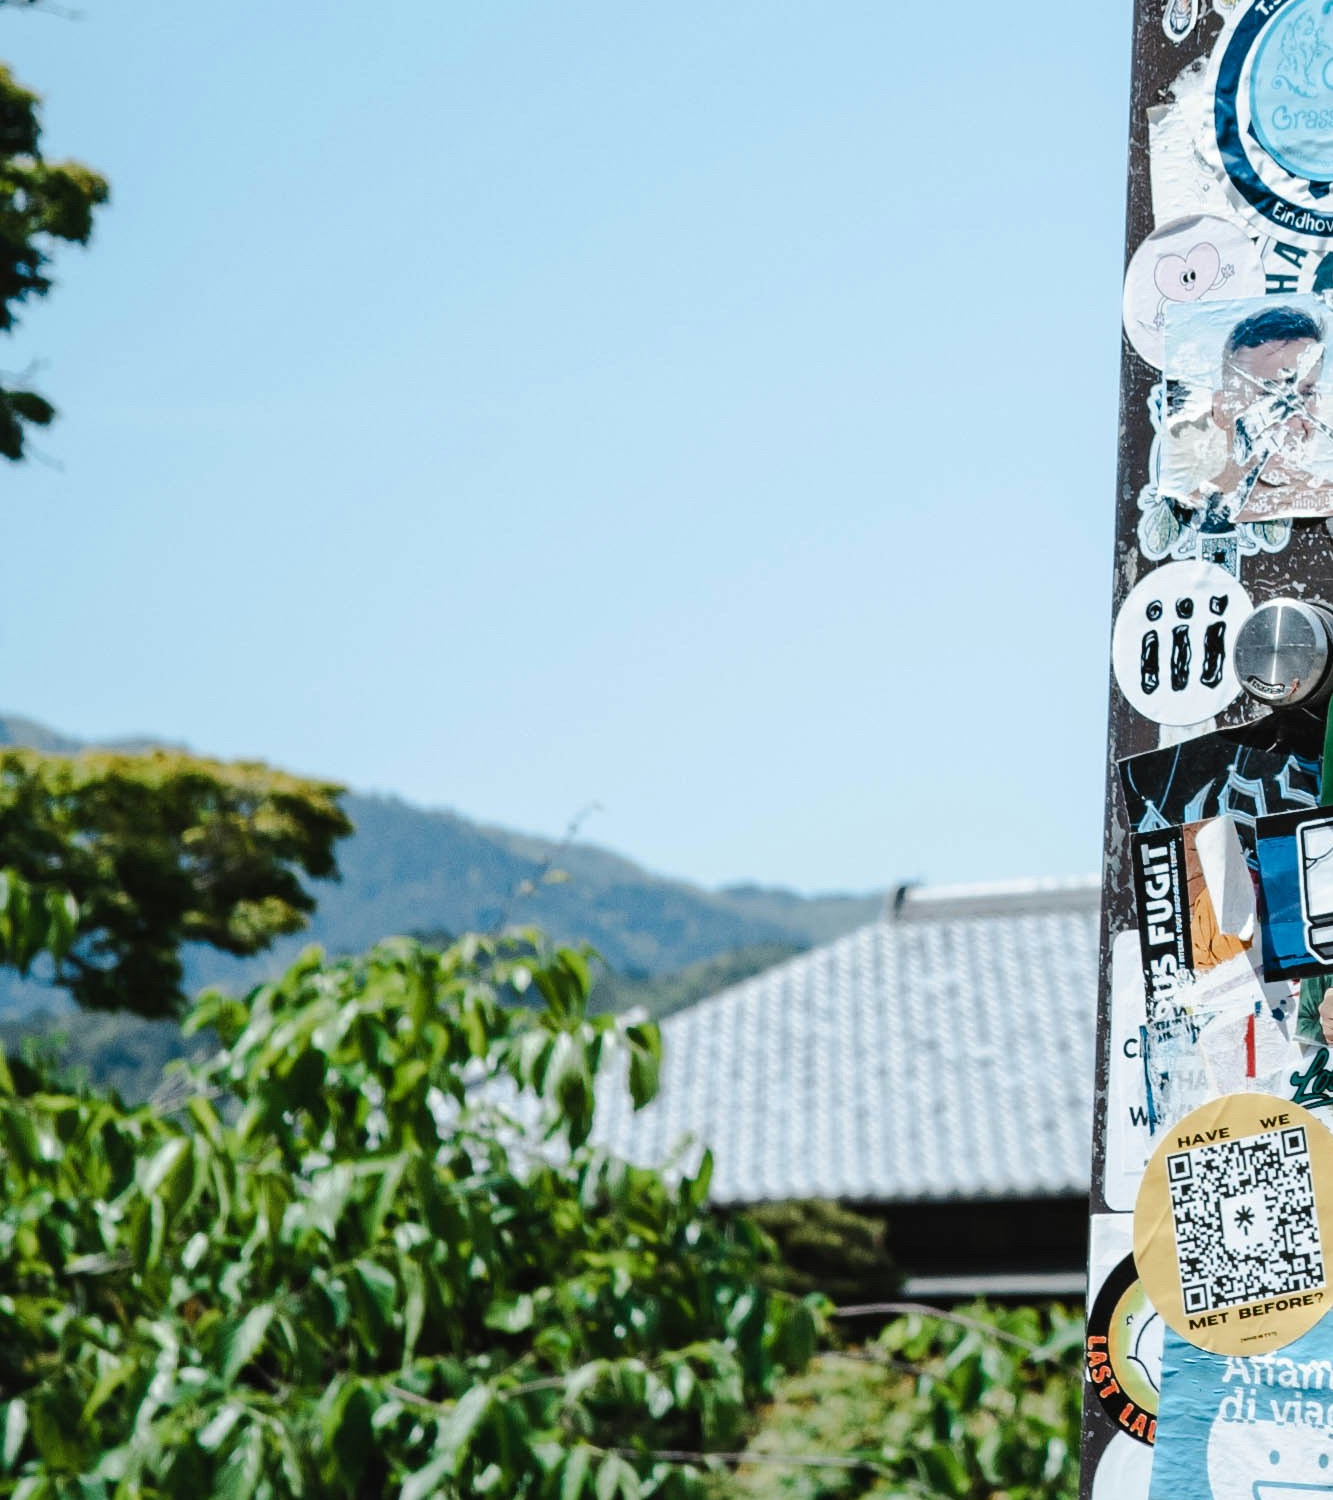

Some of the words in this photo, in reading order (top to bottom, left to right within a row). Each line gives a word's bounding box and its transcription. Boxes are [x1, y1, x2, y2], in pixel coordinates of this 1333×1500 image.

[1141, 843, 1176, 944] FUGIT
[1177, 1127, 1231, 1148] HAVE
[1260, 1113, 1291, 1130] WE
[1188, 1311, 1229, 1331] MET
[1238, 1292, 1325, 1322] BEFORE?
[1088, 1335, 1121, 1400] LAST
[1219, 1386, 1257, 1426] di
